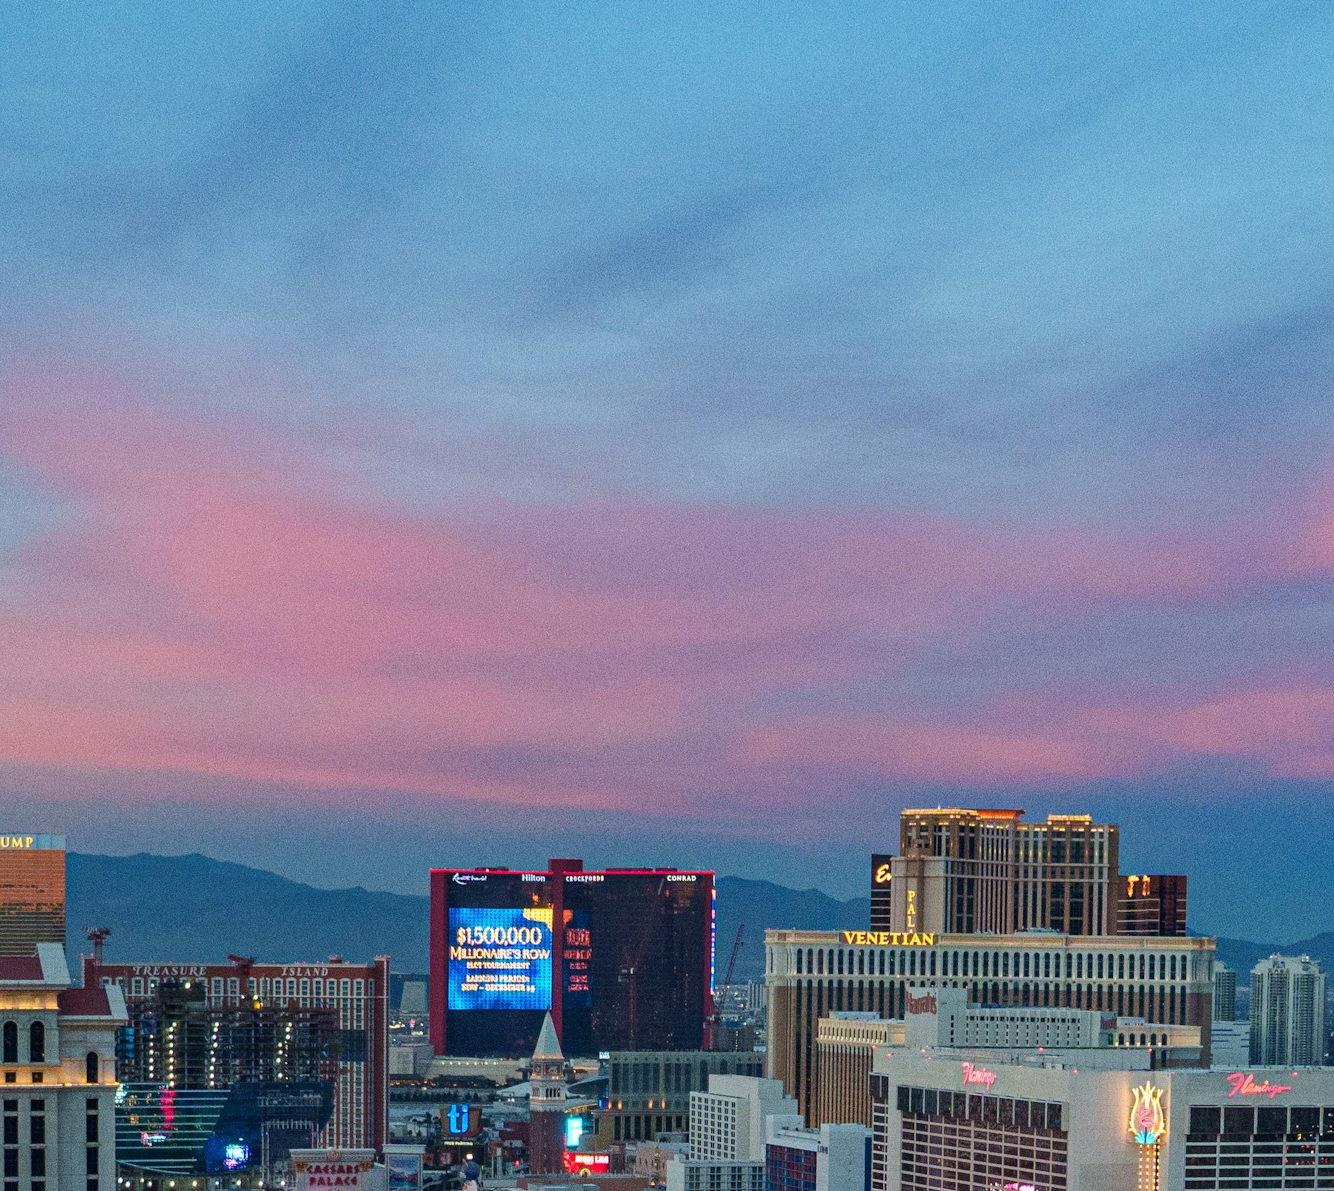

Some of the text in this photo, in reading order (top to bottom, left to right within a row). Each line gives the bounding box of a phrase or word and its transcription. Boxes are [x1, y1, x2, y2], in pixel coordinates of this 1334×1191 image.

[522, 874, 546, 882] Hilton
[456, 926, 543, 946] $1,500,000
[843, 931, 935, 946] VENETIAN
[522, 949, 551, 960] ROW
[133, 966, 329, 977] TREASURE ISLAND
[961, 1061, 998, 1090] Flamingo
[1226, 1071, 1292, 1099] Flamingo
[447, 1104, 470, 1134] ti
[306, 1165, 360, 1175] CAESARS
[309, 1176, 358, 1186] PALACE
